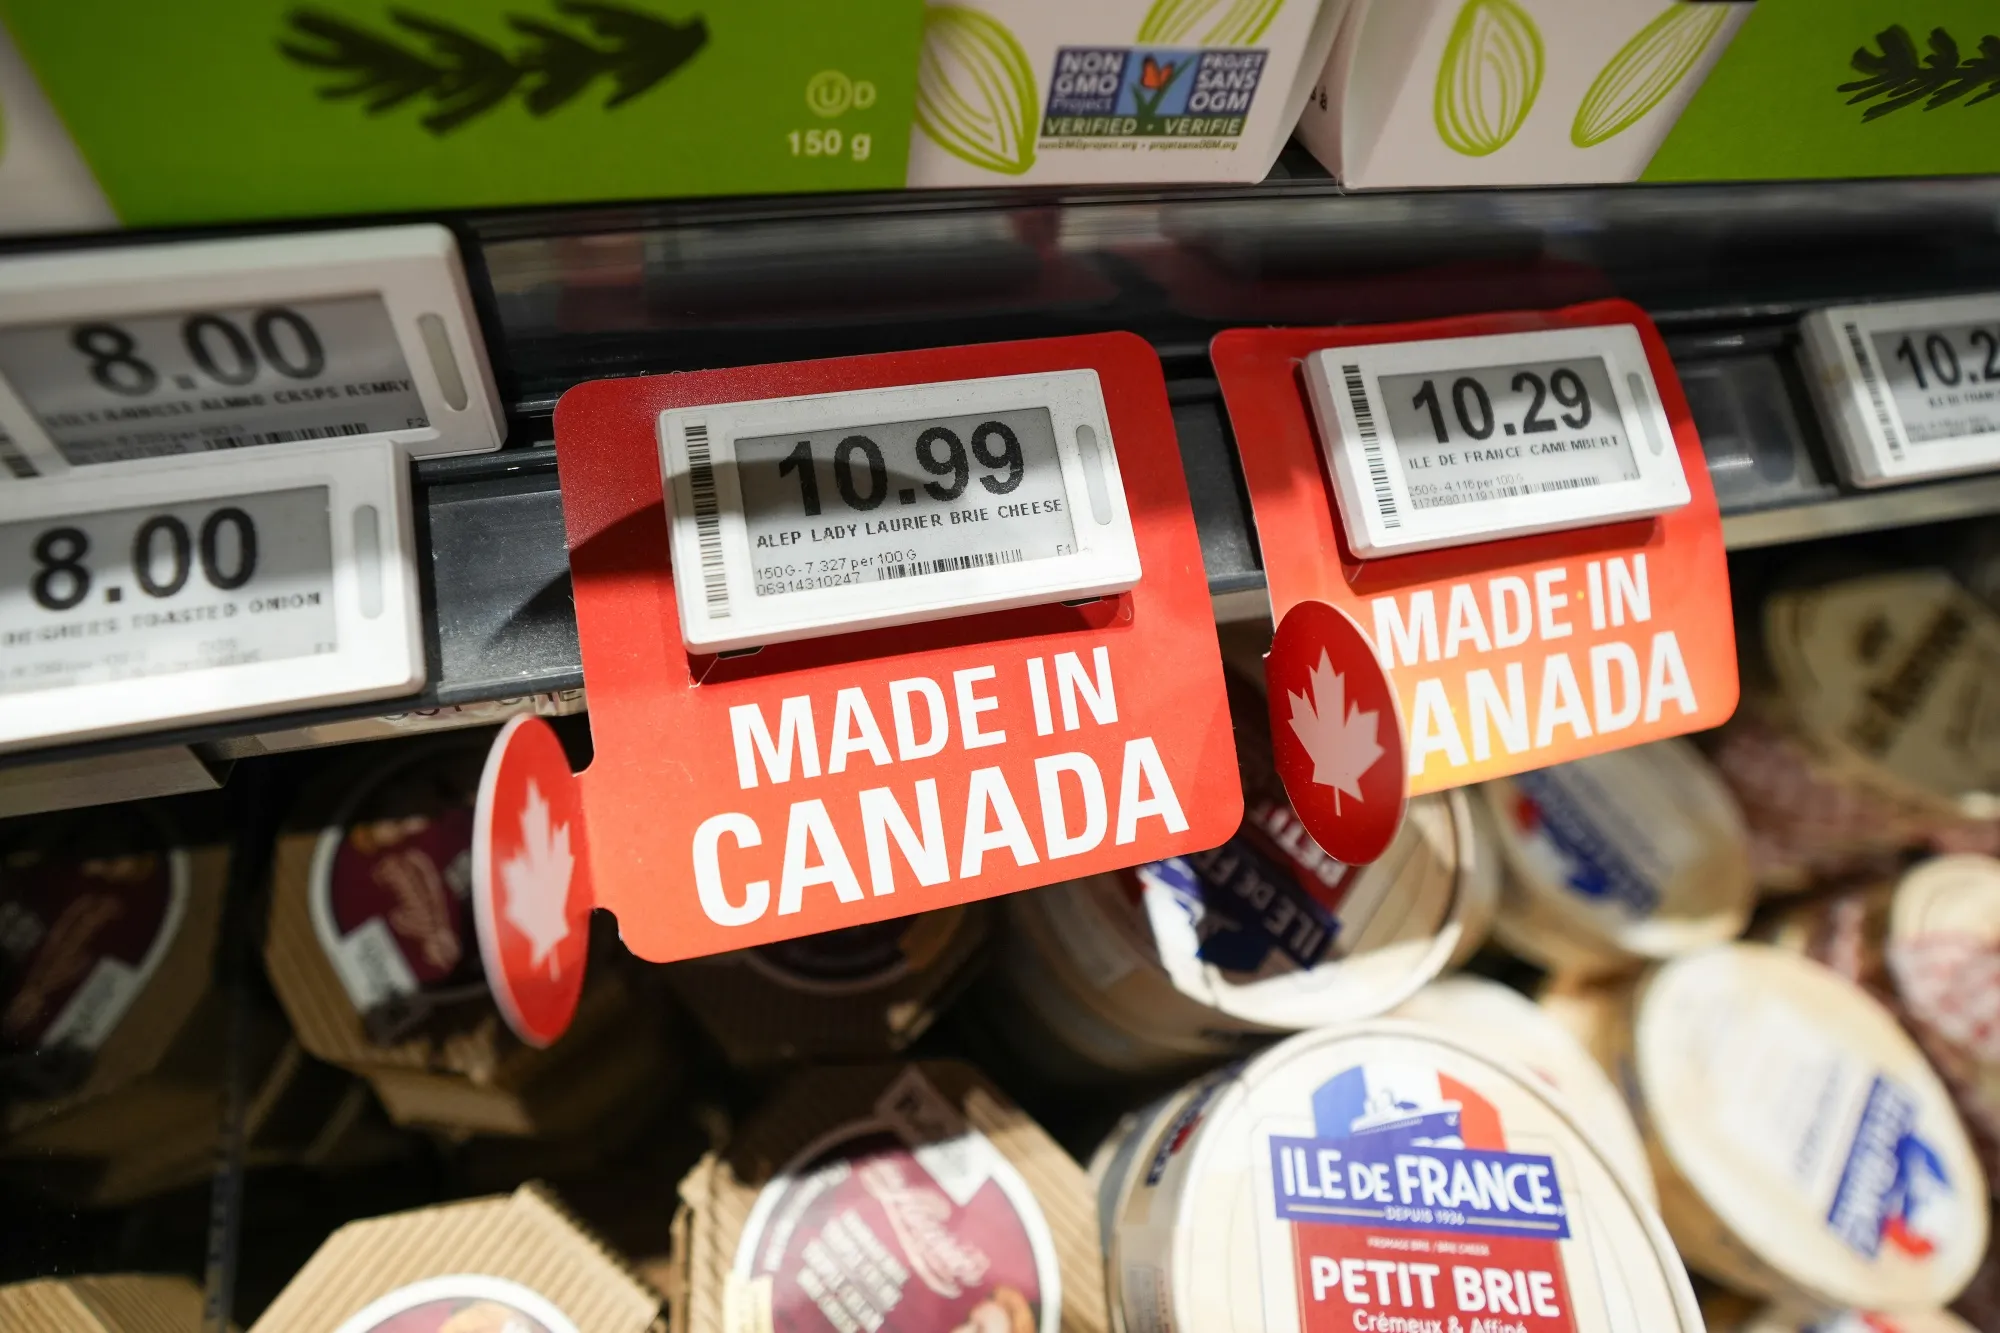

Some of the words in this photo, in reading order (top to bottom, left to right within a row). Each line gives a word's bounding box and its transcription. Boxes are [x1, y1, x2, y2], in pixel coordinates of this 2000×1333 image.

[1060, 51, 1125, 73] NON
[1198, 69, 1259, 89] SANS
[1202, 53, 1263, 69] PROJET
[1054, 74, 1118, 95] GMO
[1188, 91, 1248, 112] OGM
[1049, 98, 1112, 114] Project
[1046, 116, 1138, 135] VERIFIED
[787, 128, 843, 157] 150
[851, 132, 872, 162] g
[70, 306, 326, 397] 8.00
[1896, 328, 2000, 390] 10.2
[346, 378, 411, 398] RSMRY
[1411, 367, 1593, 444] 10.29
[778, 420, 1025, 517] 10.99
[1409, 456, 1432, 470] ILE
[1438, 453, 1458, 467] DE
[1464, 445, 1521, 464] FRANCE
[1530, 435, 1619, 456] CAMEMBERT
[756, 529, 802, 549] ALEP
[810, 523, 858, 543] LADY
[865, 512, 944, 536] LAURIER
[950, 507, 989, 526] BRIE
[997, 499, 1063, 519] CHEESE
[31, 506, 258, 611] 8.00
[851, 557, 874, 571] per
[130, 602, 239, 631] TOASTED
[247, 591, 322, 616] ONION
[1371, 566, 1573, 670] MADE
[1586, 553, 1652, 631] IN
[728, 665, 1007, 790] MADE
[1026, 646, 1119, 737] IN
[1406, 631, 1699, 777] ANADA
[691, 736, 1190, 927] CANADA
[1280, 1146, 1346, 1200] ILE
[1347, 1160, 1394, 1203] DE
[1394, 1154, 1558, 1216] FRANCE
[1384, 1205, 1434, 1224] DEPUIS
[1436, 1207, 1466, 1226] 1936
[1309, 1255, 1441, 1309] PETIT
[1452, 1265, 1561, 1318] BRIE
[1352, 1308, 1443, 1333] Crémeux
[1447, 1314, 1464, 1333] &
